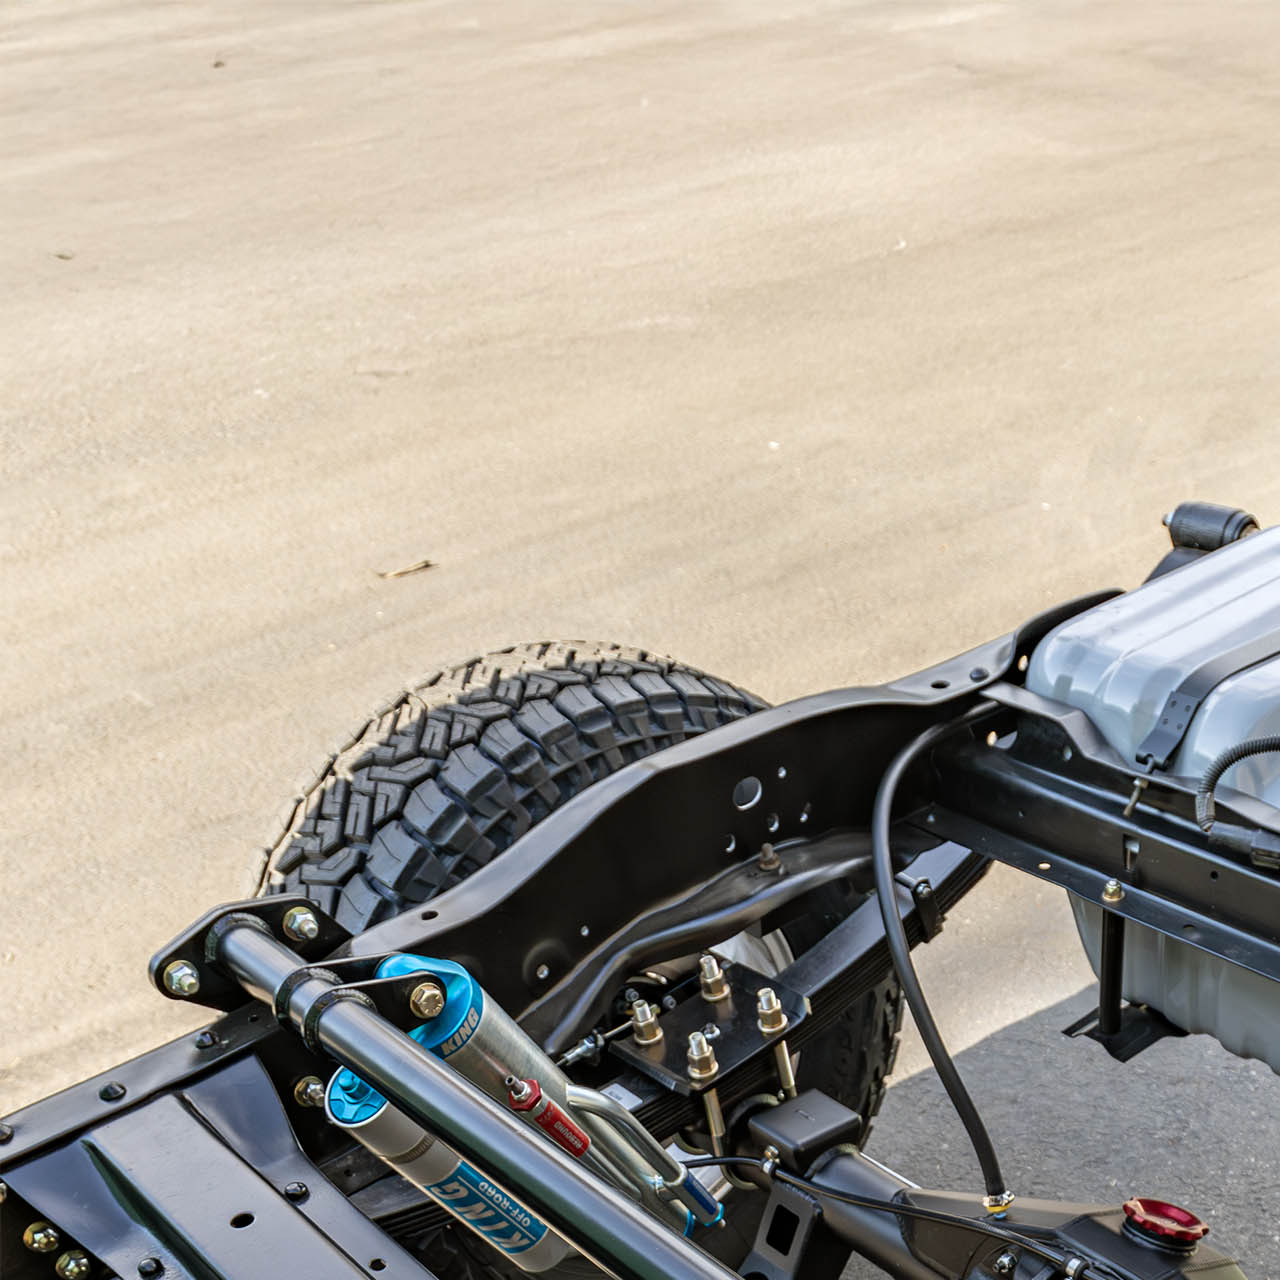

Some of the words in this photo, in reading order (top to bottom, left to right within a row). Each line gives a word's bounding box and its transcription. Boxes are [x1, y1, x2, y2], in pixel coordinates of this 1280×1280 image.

[441, 1007, 480, 1056] KING
[431, 1182, 531, 1250] KING
[477, 1181, 532, 1229] OFF-ROAD
